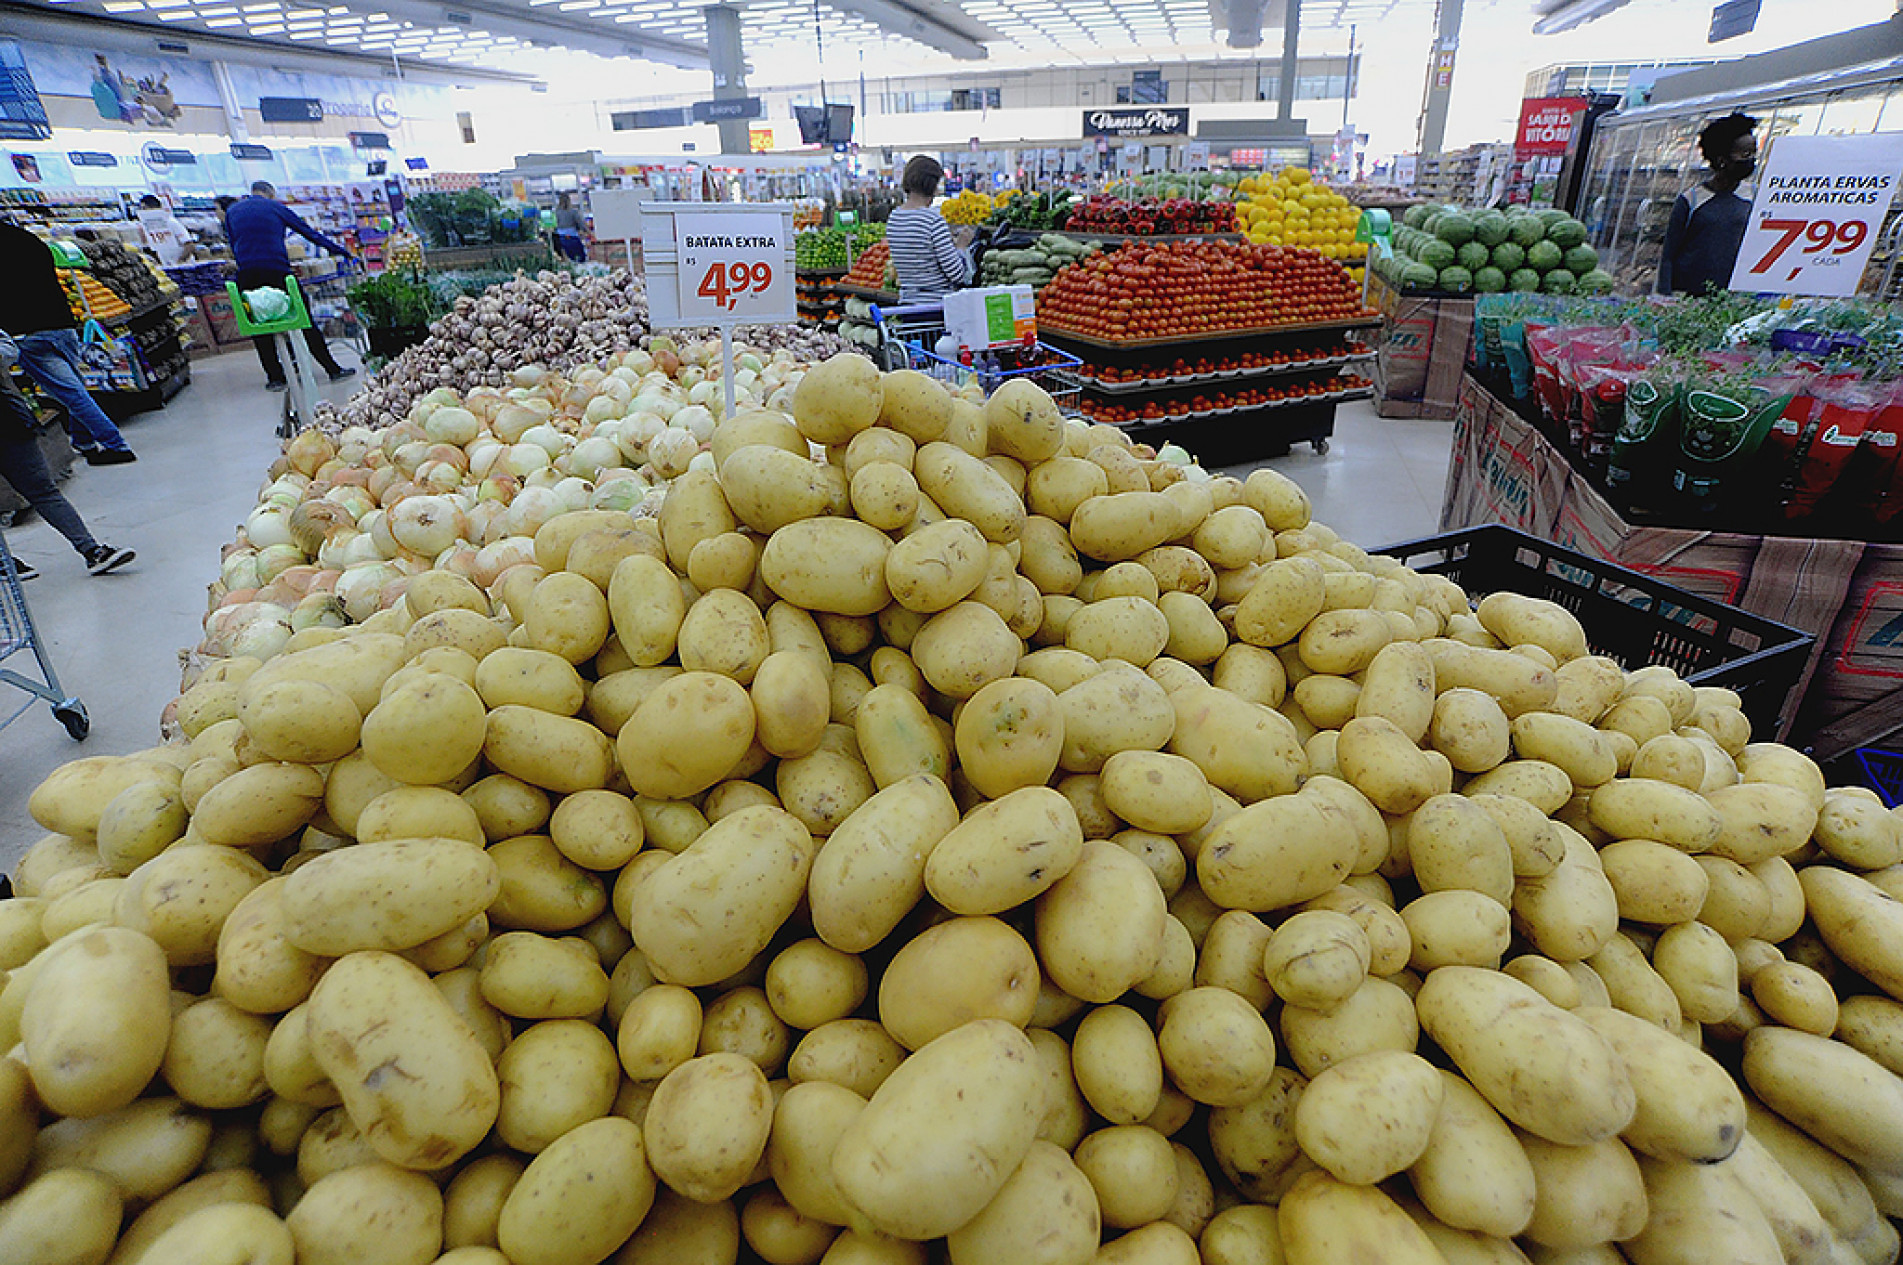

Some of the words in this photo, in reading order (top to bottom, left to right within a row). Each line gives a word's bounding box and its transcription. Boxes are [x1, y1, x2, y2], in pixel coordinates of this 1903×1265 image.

[1768, 176, 1831, 188] PLANTA
[1833, 176, 1891, 188] ERVAS
[1768, 191, 1879, 204] AROMATICAS
[685, 235, 733, 248] BATATA
[735, 235, 777, 248] EXTRA
[1749, 220, 1868, 281] 7,99
[1811, 257, 1841, 266] CADA
[697, 261, 773, 312] 4,99
